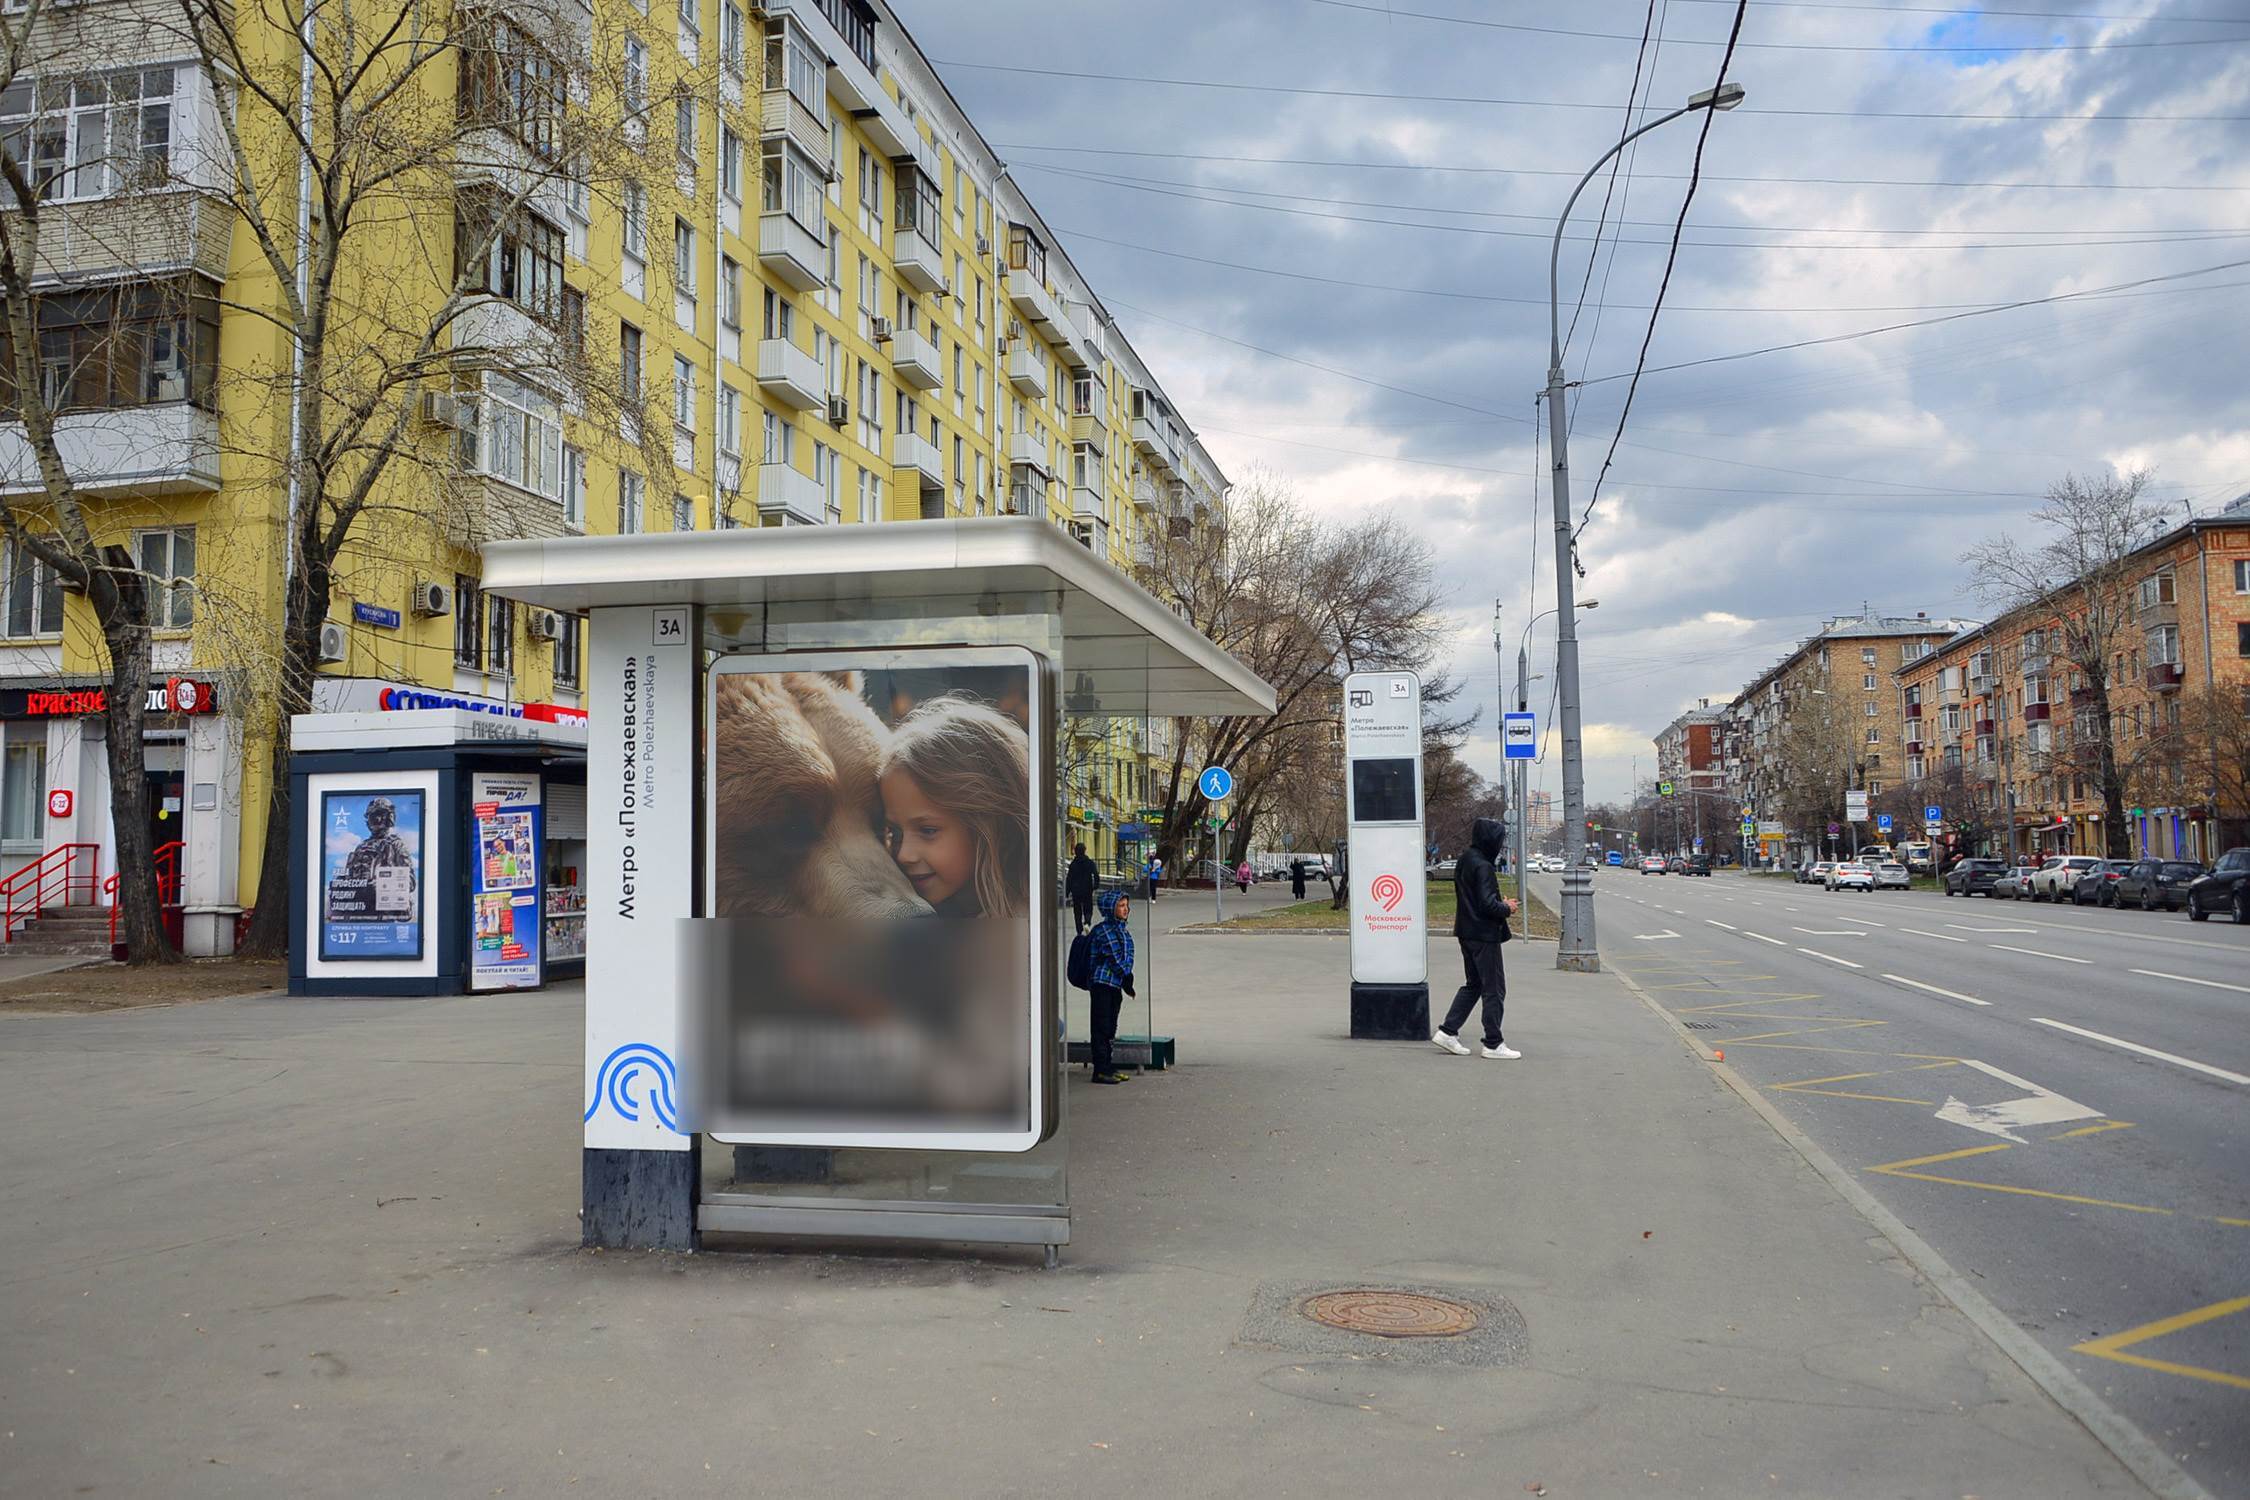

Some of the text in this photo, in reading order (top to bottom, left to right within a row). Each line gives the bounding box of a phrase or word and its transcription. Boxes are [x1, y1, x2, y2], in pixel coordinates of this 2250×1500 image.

[660, 619, 680, 635] 3А
[642, 655, 655, 808] Metro Polezhaevskaya
[619, 656, 638, 920] Метро «Полежаевская»
[1364, 914, 1412, 922] Московский
[1369, 923, 1408, 931] Транспорт
[338, 932, 357, 944] 117
